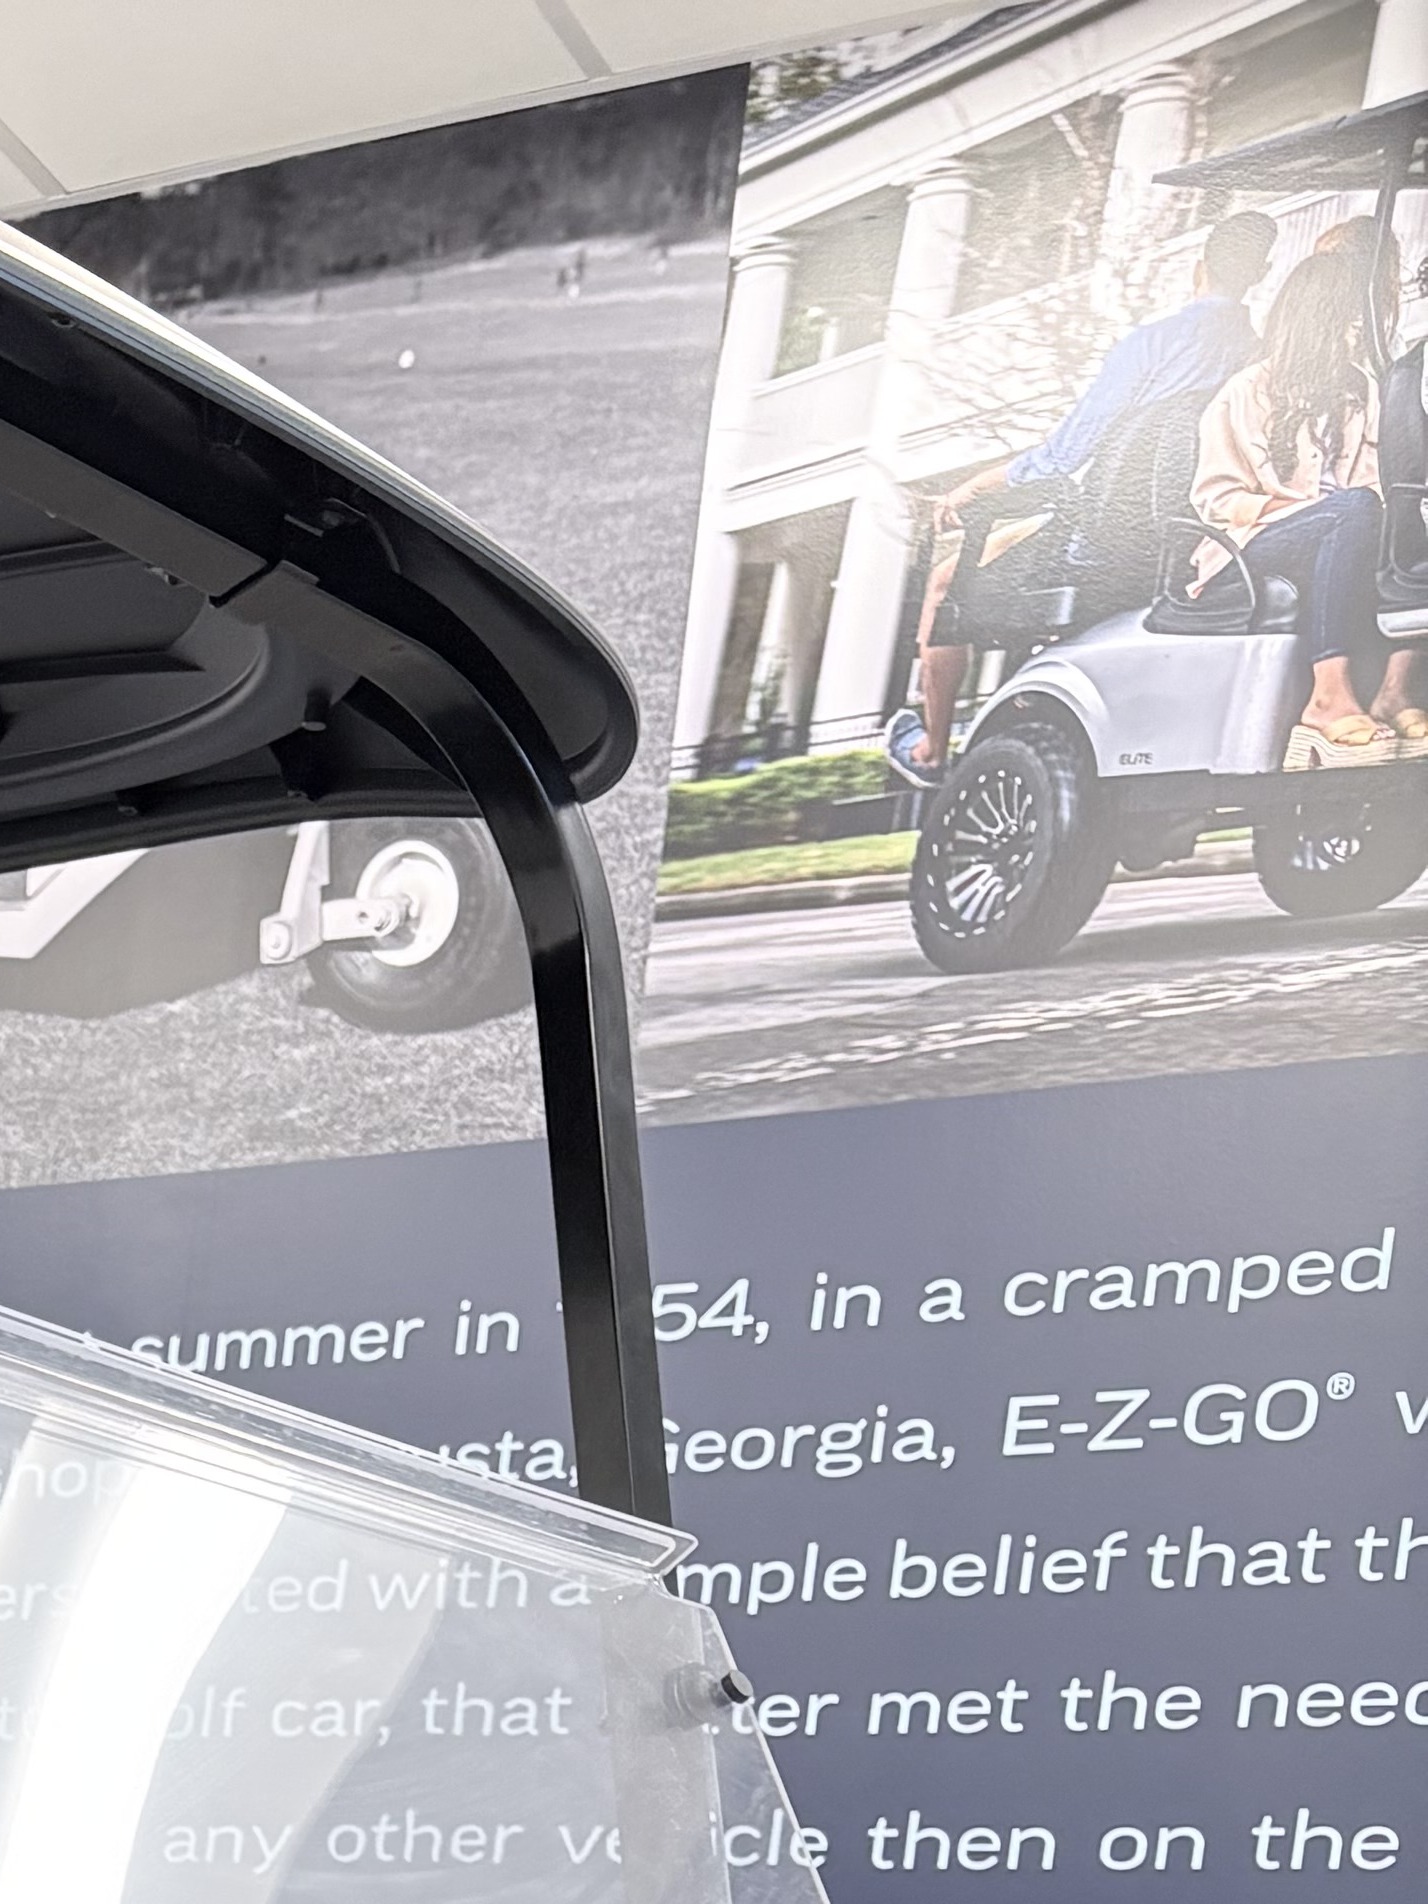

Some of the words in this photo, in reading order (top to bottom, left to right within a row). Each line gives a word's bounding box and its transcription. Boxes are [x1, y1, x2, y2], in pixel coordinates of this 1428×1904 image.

[130, 1310, 425, 1373] summer
[455, 1298, 521, 1356] in
[809, 1272, 882, 1331] in
[918, 1276, 966, 1326] a
[1003, 1227, 1397, 1318] cramped
[367, 1553, 529, 1612] with
[678, 1540, 868, 1615] mple
[889, 1530, 1132, 1600] belief
[1147, 1524, 1330, 1591] that
[270, 1696, 393, 1747] car,
[420, 1682, 573, 1738] that
[866, 1677, 1030, 1737] met
[1060, 1669, 1202, 1732] the
[161, 1822, 294, 1876] any
[327, 1808, 524, 1865] other
[865, 1810, 1058, 1872] then
[1098, 1814, 1207, 1872] on
[1251, 1808, 1401, 1872] the
